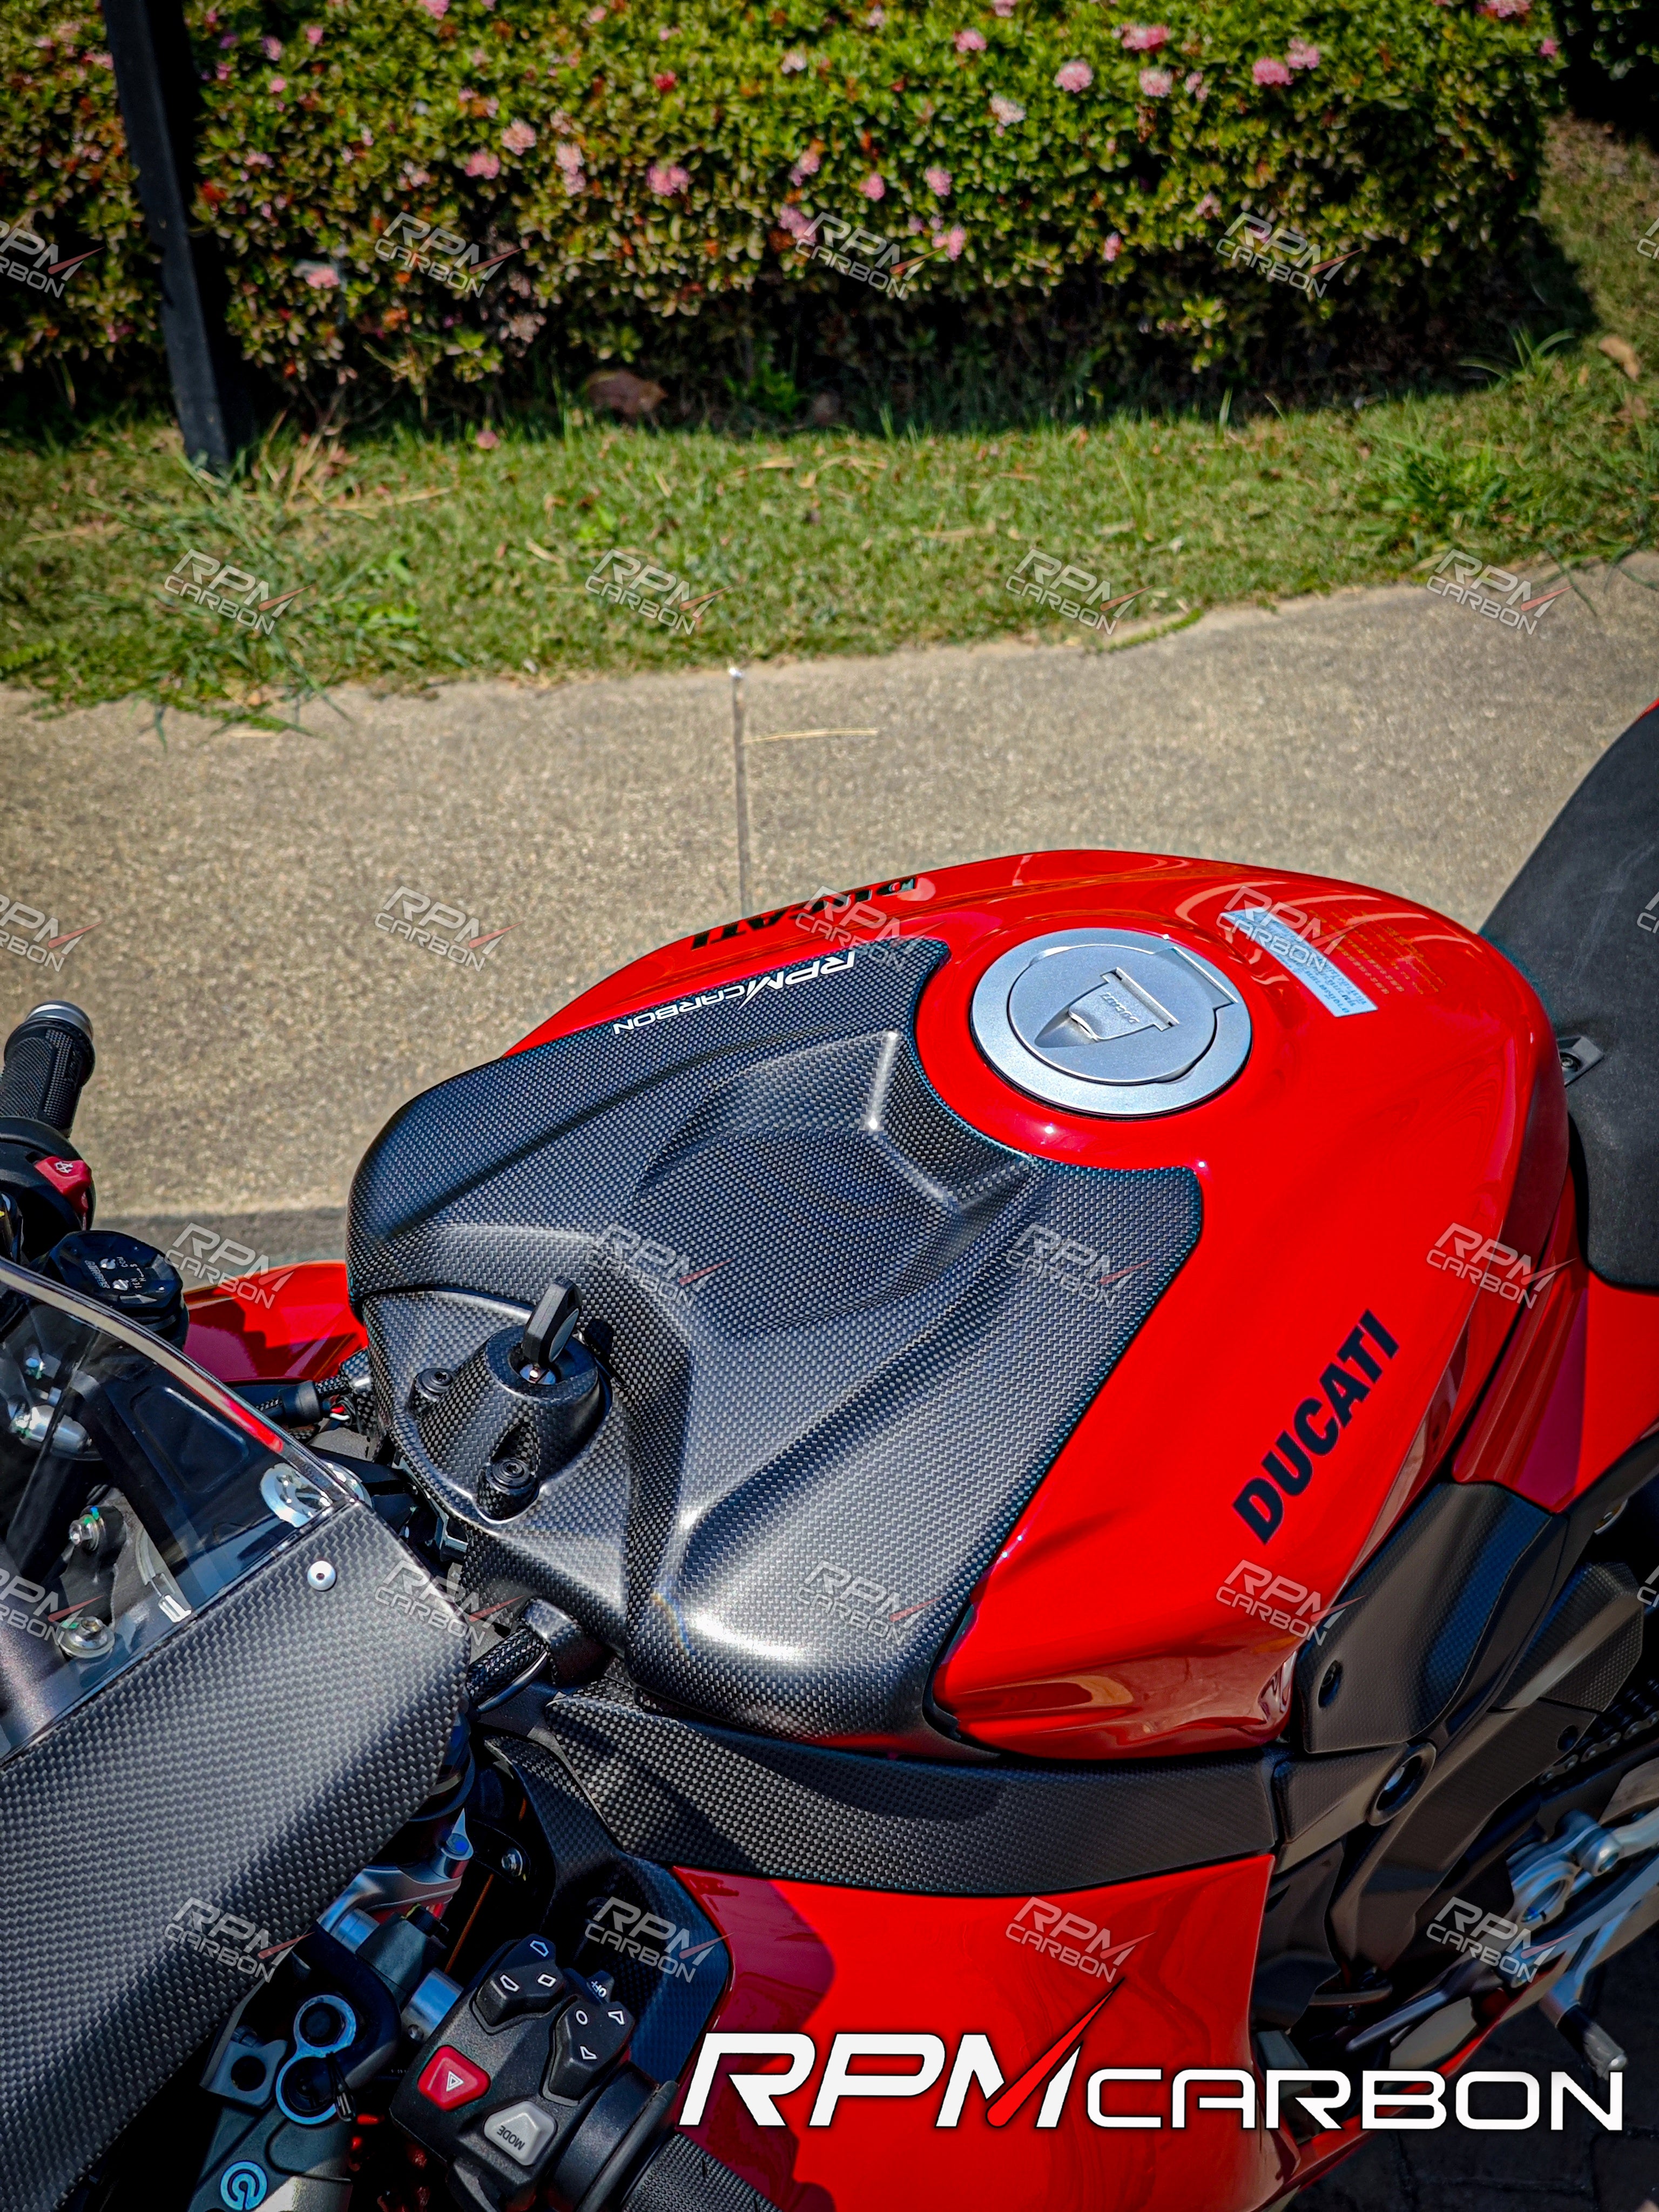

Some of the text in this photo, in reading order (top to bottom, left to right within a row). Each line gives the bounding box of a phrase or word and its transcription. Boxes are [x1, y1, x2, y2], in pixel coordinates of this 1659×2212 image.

[1232, 1308, 1400, 1546] DUCATI
[591, 1981, 606, 1998] OFF
[497, 2125, 525, 2150] MODE
